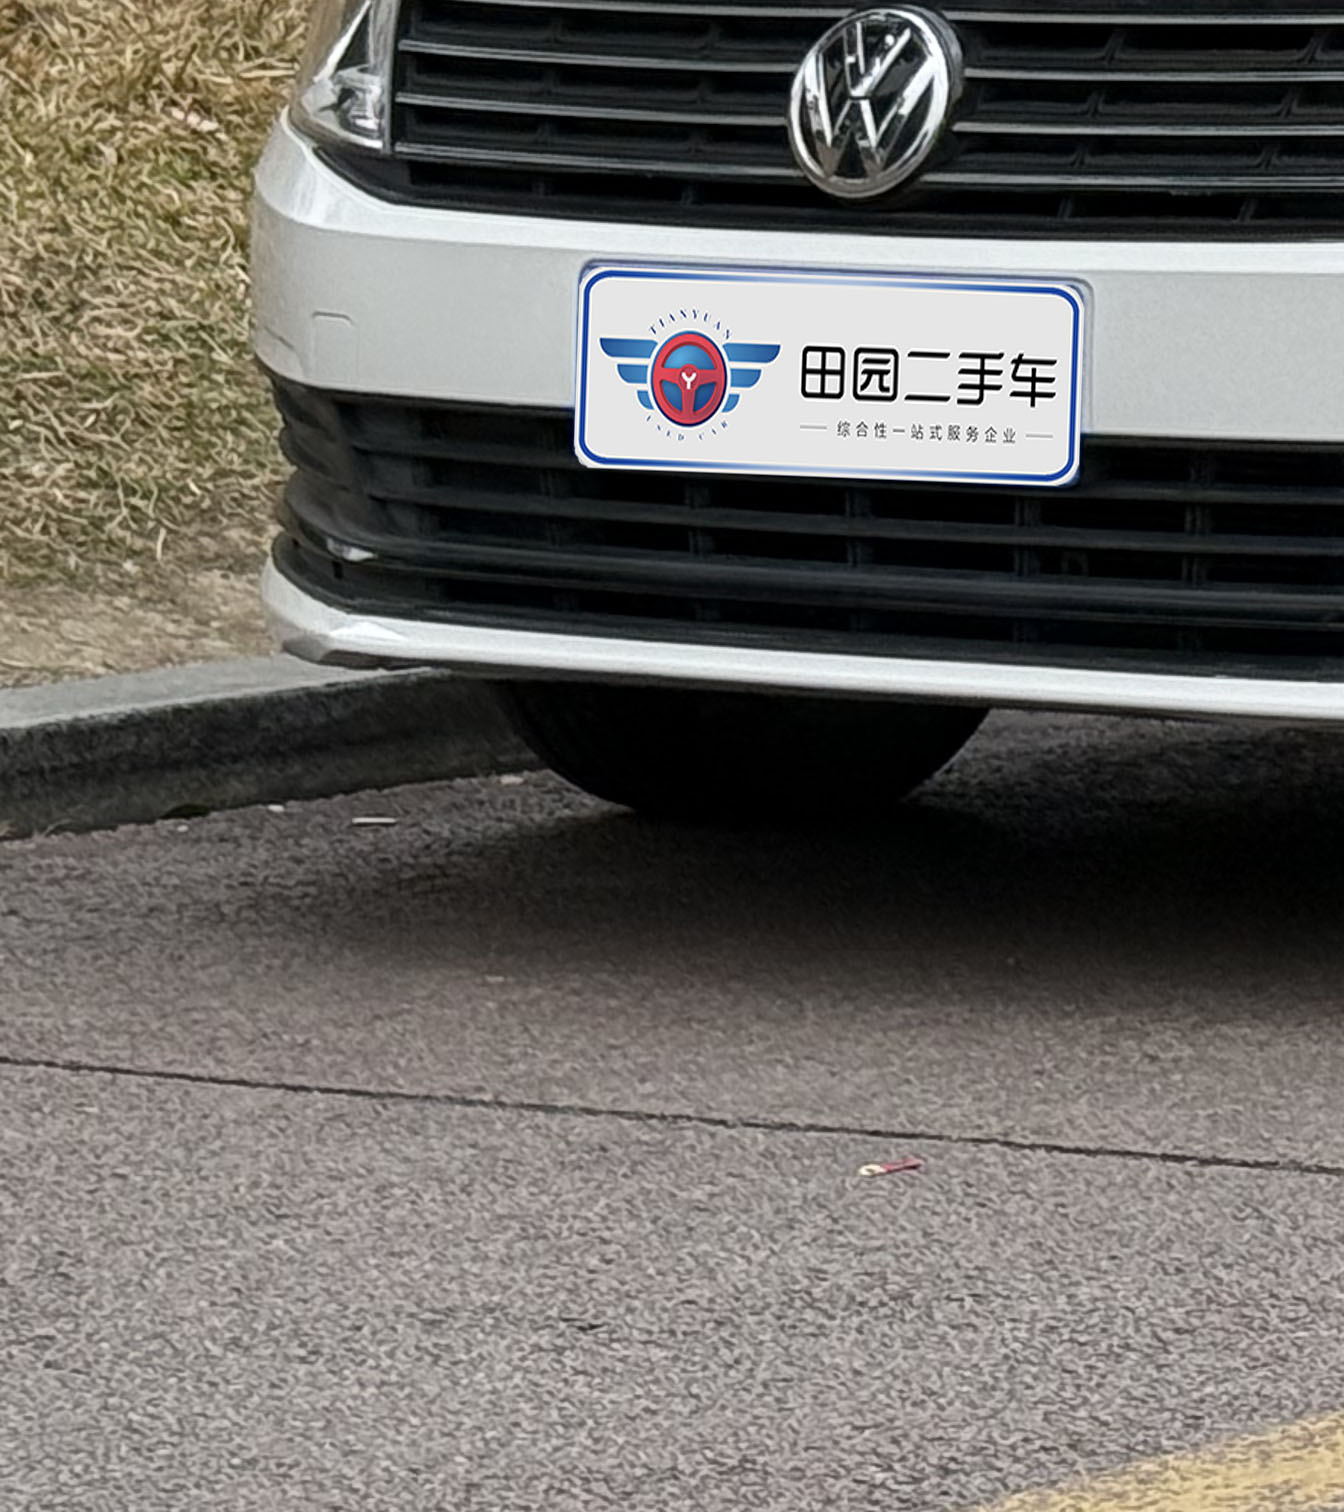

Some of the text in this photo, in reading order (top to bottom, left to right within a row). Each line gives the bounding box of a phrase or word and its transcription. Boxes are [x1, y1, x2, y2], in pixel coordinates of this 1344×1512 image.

[800, 345, 1057, 407] 田园二手车
[837, 420, 1016, 444] 综合性一站式服务企业
